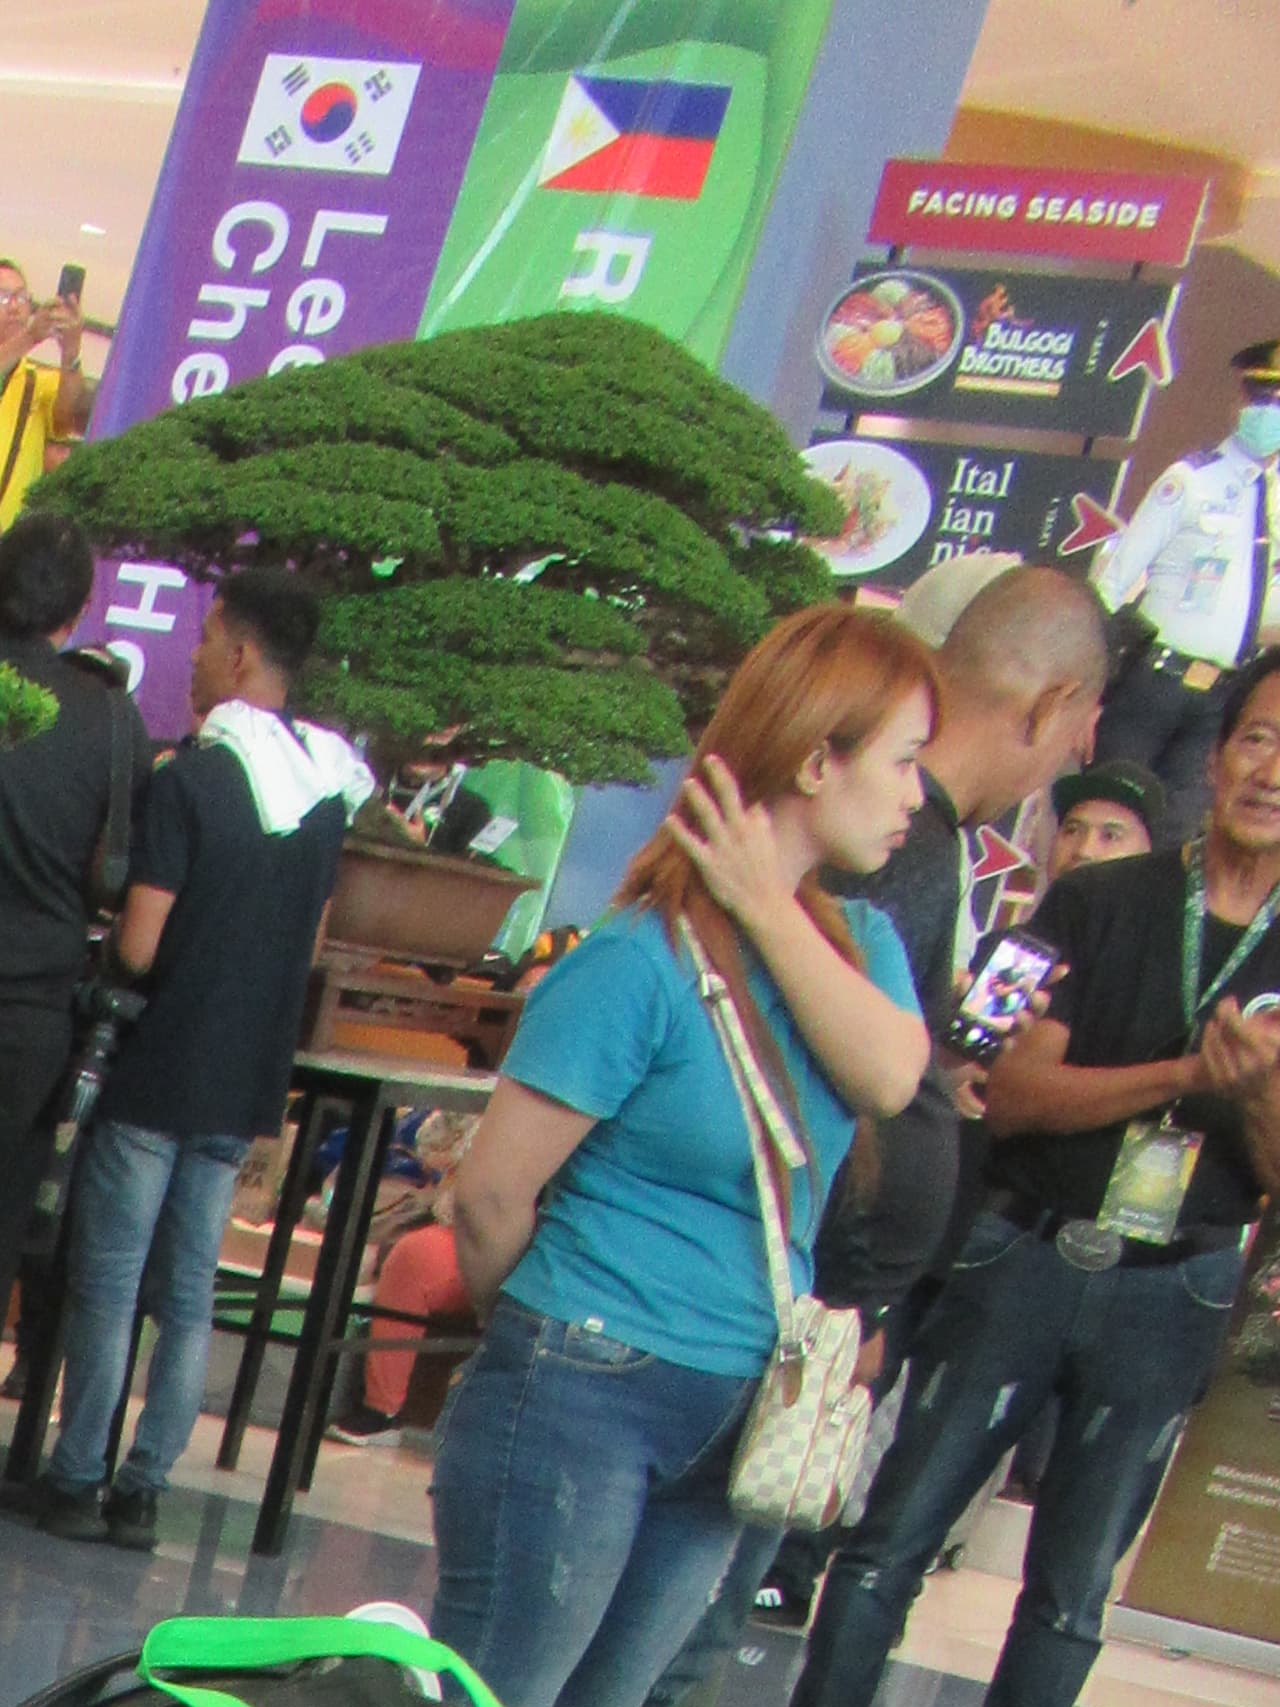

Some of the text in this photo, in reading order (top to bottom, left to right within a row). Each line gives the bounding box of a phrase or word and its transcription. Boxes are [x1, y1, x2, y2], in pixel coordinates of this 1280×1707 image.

[908, 189, 1162, 228] FACING SEASIDE
[984, 322, 1074, 355] BULGOGI
[958, 346, 1065, 380] BROTHERS
[948, 457, 1014, 498] Ital
[939, 498, 995, 536] ian
